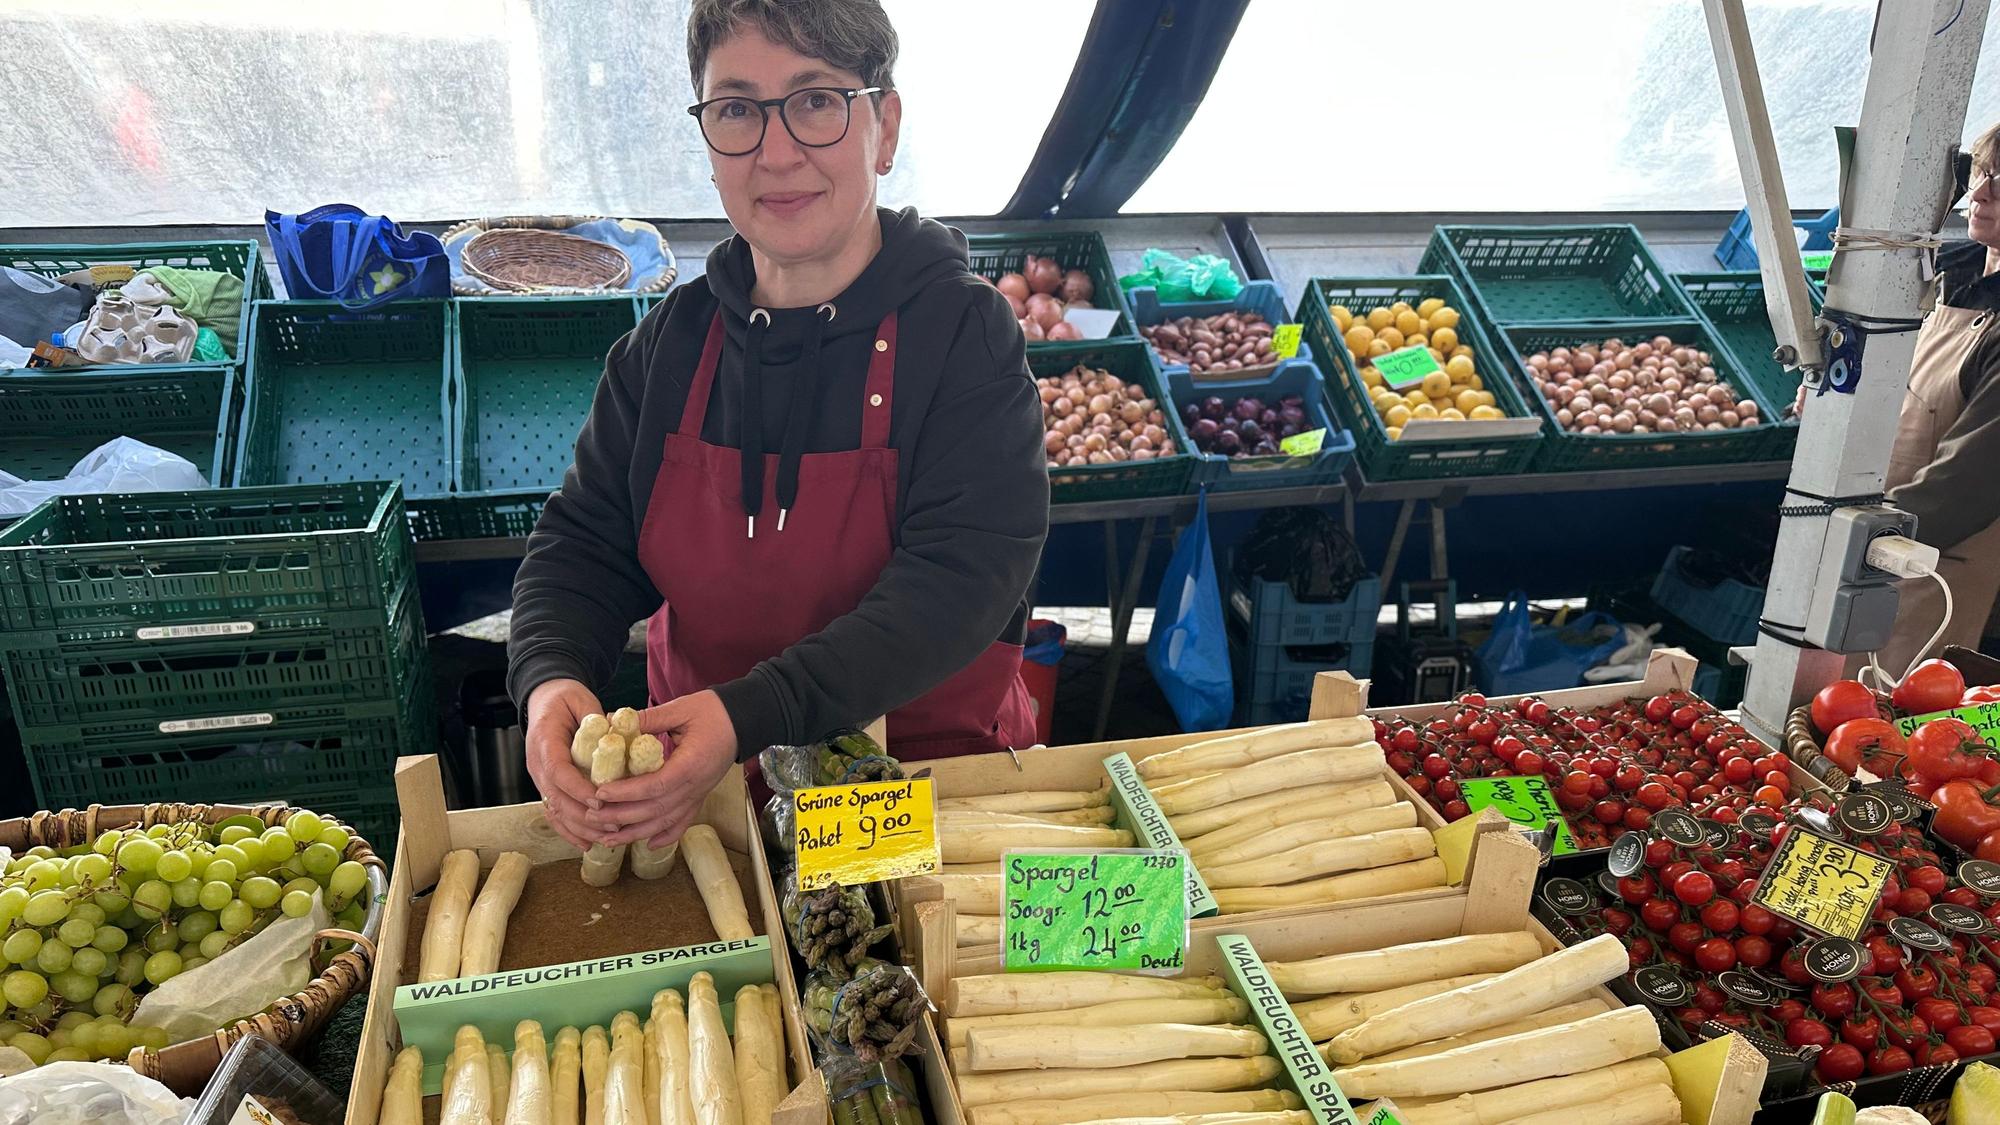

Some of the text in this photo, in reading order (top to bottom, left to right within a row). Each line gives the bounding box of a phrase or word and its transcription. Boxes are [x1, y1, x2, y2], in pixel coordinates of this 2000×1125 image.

[848, 782, 913, 814] Spargel
[1111, 758, 1173, 849] WALDFEUCHTER
[1865, 801, 1877, 825] HONIG
[798, 821, 843, 852] Paket
[1624, 843, 1637, 868] HONIG
[1010, 855, 1178, 894] Spargel 1270
[1558, 894, 1583, 902] HONIG
[410, 939, 759, 1001] WALDFEUCHTER SPARGEL
[1822, 952, 1851, 971] HONIG
[1652, 982, 1678, 994] HONIG
[1733, 984, 1762, 995] HONIG
[1229, 942, 1321, 1080] WALDFEUCHTER
